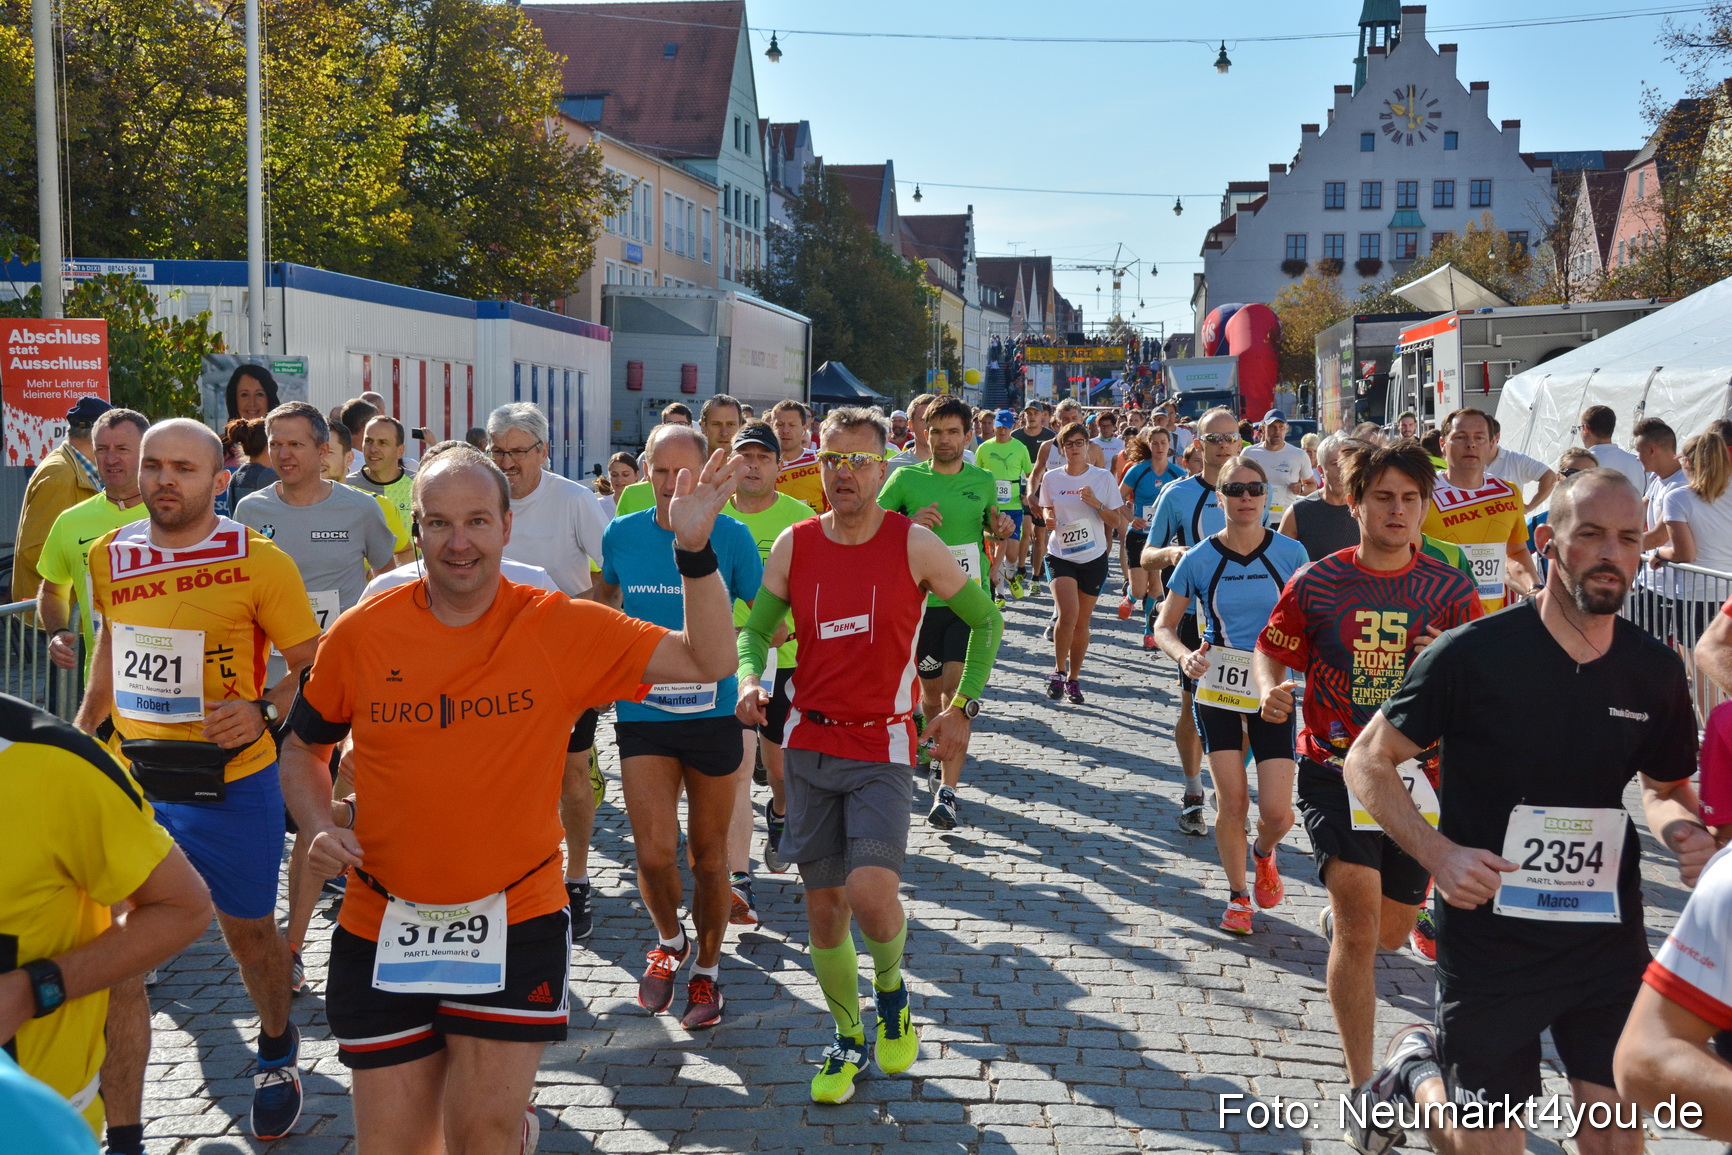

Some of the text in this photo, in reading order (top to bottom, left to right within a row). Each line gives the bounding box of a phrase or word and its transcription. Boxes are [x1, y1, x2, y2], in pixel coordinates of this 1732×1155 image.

[8, 328, 101, 345] Abschluss
[9, 346, 39, 355] statt
[1057, 349, 1092, 359] START
[10, 357, 102, 370] Ausschluss!
[26, 379, 99, 388] Mehr Lehrer für
[23, 390, 100, 399] kleinere Klassen.
[54, 426, 66, 438] DI
[791, 466, 821, 480] BÖGL
[1442, 500, 1518, 528] MAX BÖGL
[311, 530, 349, 540] BOCK
[1062, 528, 1089, 544] 2275
[111, 567, 250, 607] MAX BÖGL
[834, 622, 856, 632] DEHN
[1353, 610, 1408, 652] 35
[135, 633, 174, 648] BOCK
[1266, 622, 1301, 651] 2018
[1222, 653, 1251, 664] BOCK
[1352, 651, 1406, 670] HOME
[124, 650, 182, 684] 2421
[918, 662, 942, 672] adidas
[1364, 668, 1404, 677] TRIATHLON
[1217, 664, 1248, 687] 161
[129, 682, 172, 694] PARTL Neumarkt
[1352, 687, 1400, 699] FINISHE
[136, 696, 171, 712] Robert
[371, 688, 534, 723] EURO POLES
[658, 695, 697, 705] Manfred
[1217, 694, 1240, 705] Anika
[1352, 697, 1376, 706] RELAY
[1544, 817, 1594, 831] BOCK
[1520, 838, 1604, 874] 2354
[1526, 876, 1552, 885] PARTL
[1536, 893, 1579, 909] Marco
[417, 905, 471, 920] BOCK
[398, 914, 489, 946] 3129
[404, 950, 430, 958] PARTL
[528, 993, 554, 1004] adidas
